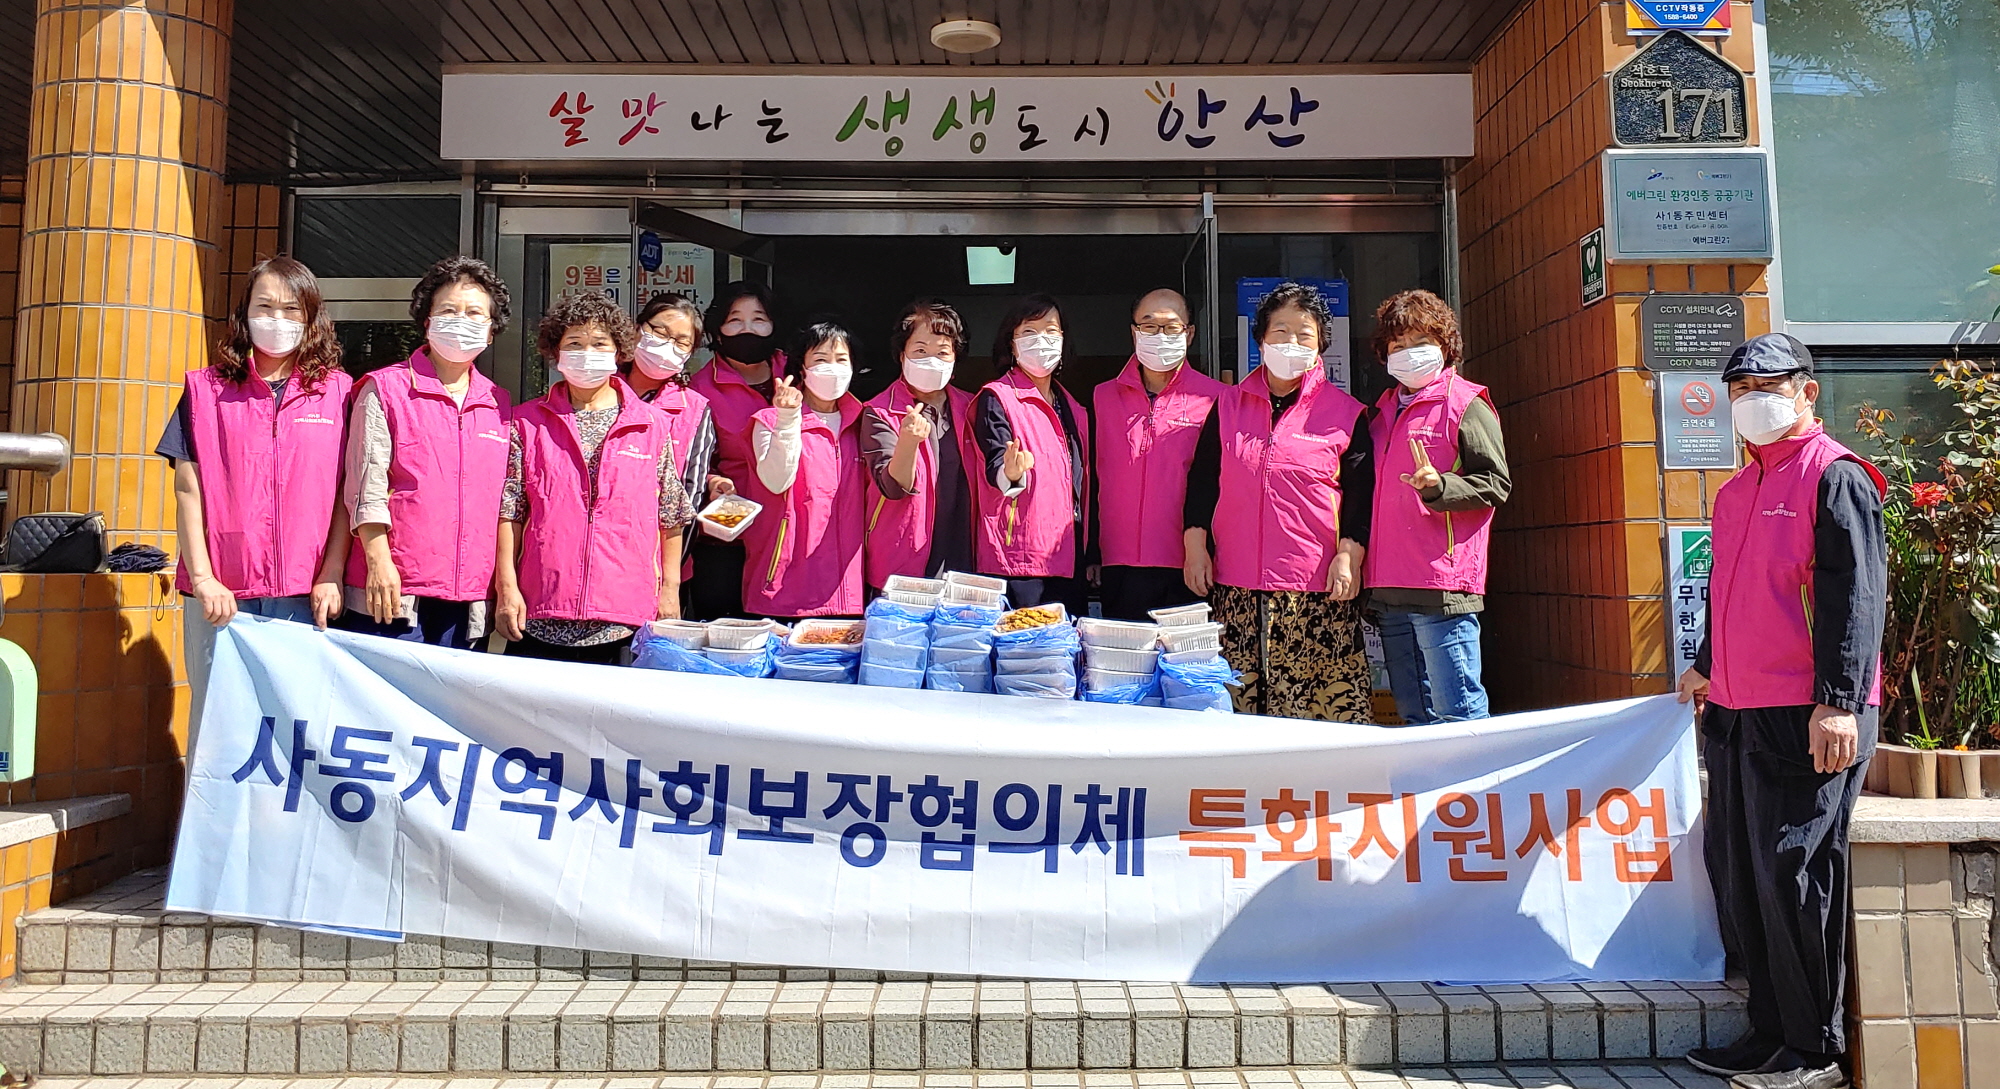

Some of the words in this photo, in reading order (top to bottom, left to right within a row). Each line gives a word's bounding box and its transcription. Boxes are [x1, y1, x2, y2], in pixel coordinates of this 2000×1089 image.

[1656, 4, 1705, 13] CCTV작동중
[1620, 78, 1672, 88] Seokho-ro
[1144, 81, 1322, 149] 안산
[1655, 88, 1742, 139] 171
[1626, 190, 1667, 202] 에버그린
[1670, 189, 1710, 202] 환경인증
[1714, 189, 1754, 202] 공공기관
[1655, 210, 1729, 221] 사1동주민센터
[640, 243, 660, 260] ADT
[565, 265, 621, 287] 9월은
[1660, 305, 1683, 314] CCTV
[1685, 305, 1715, 314] 설치안내
[1669, 359, 1693, 367] CCTV
[1681, 418, 1716, 428] 금연건물
[232, 716, 1148, 878] 사동지역사회보장협의체
[1179, 787, 1674, 884] 특화지원사업
